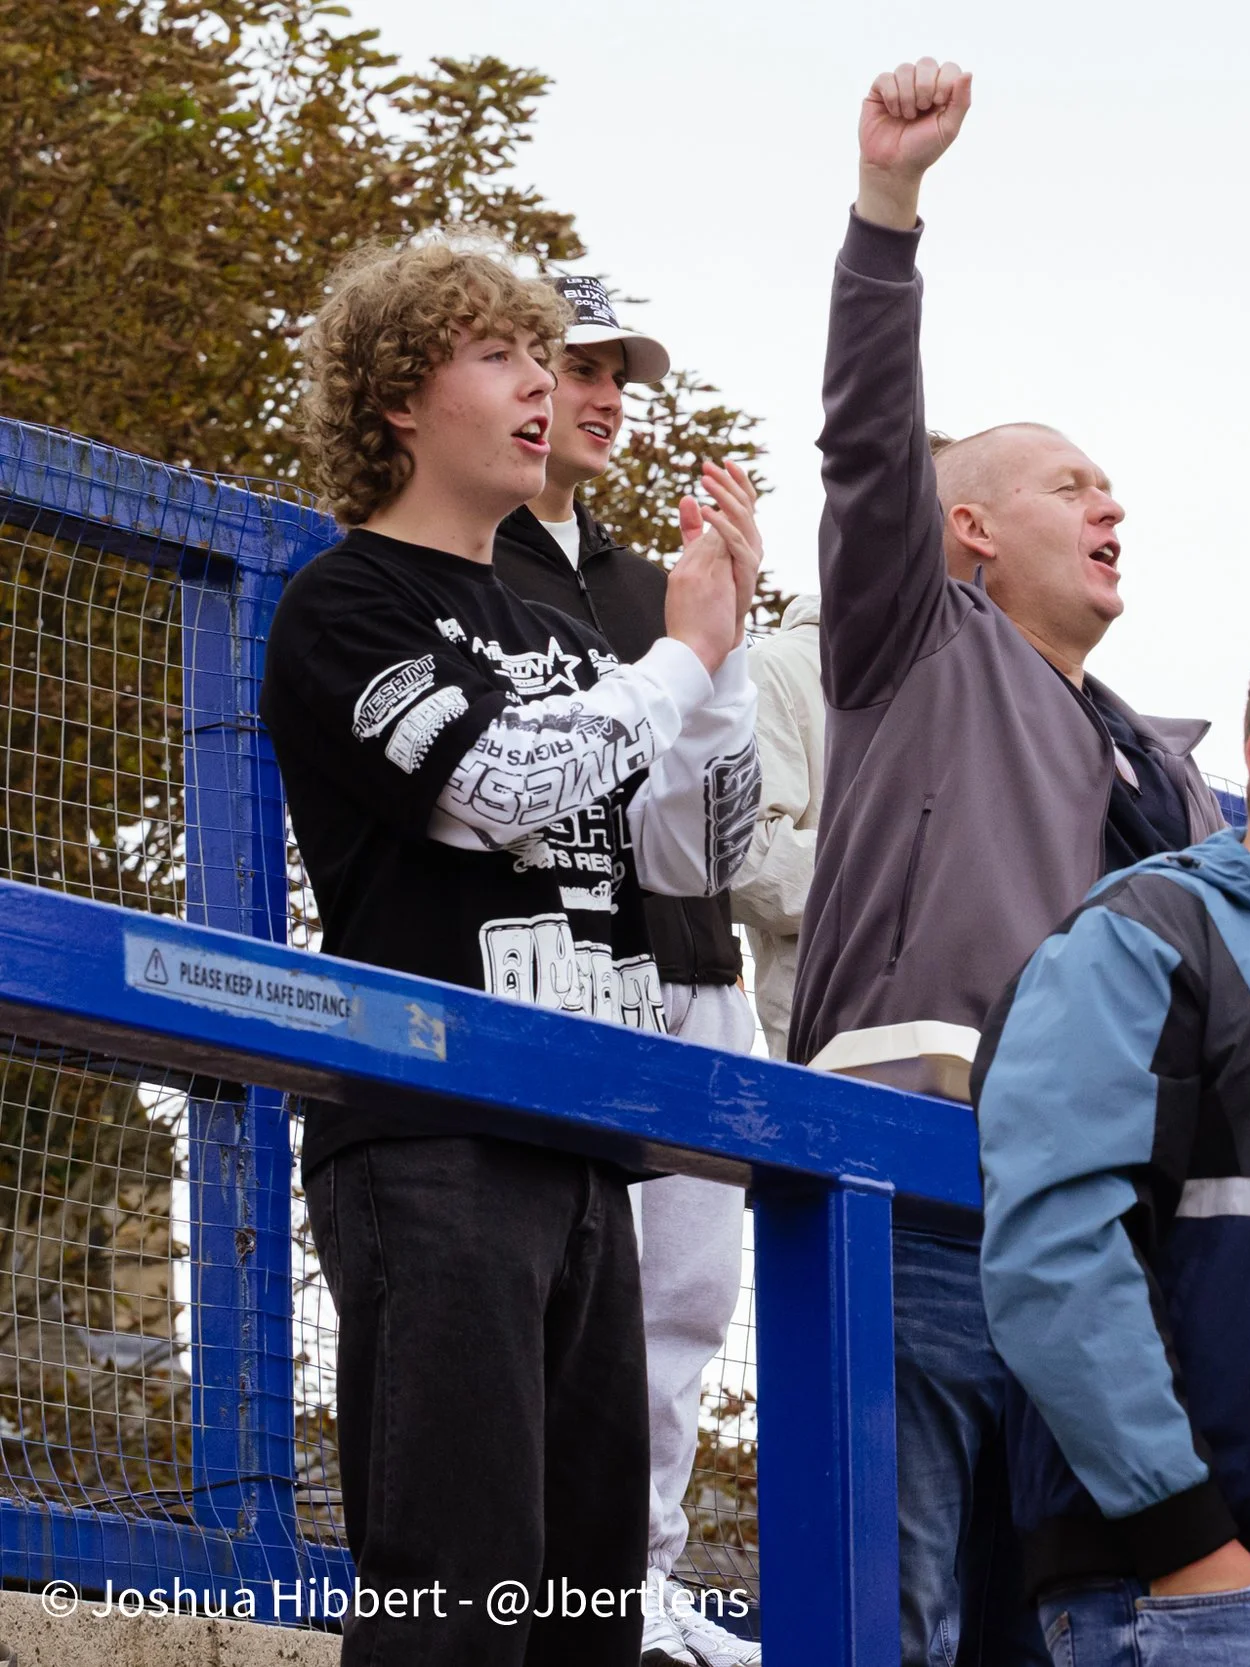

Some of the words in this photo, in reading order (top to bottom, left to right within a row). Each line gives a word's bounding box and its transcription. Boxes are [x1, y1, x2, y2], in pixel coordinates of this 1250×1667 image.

[180, 961, 223, 990] PLEASE
[224, 972, 254, 997] KEEP
[255, 980, 264, 998] A
[266, 981, 294, 1007] SAFE
[296, 987, 351, 1019] DISTANCE
